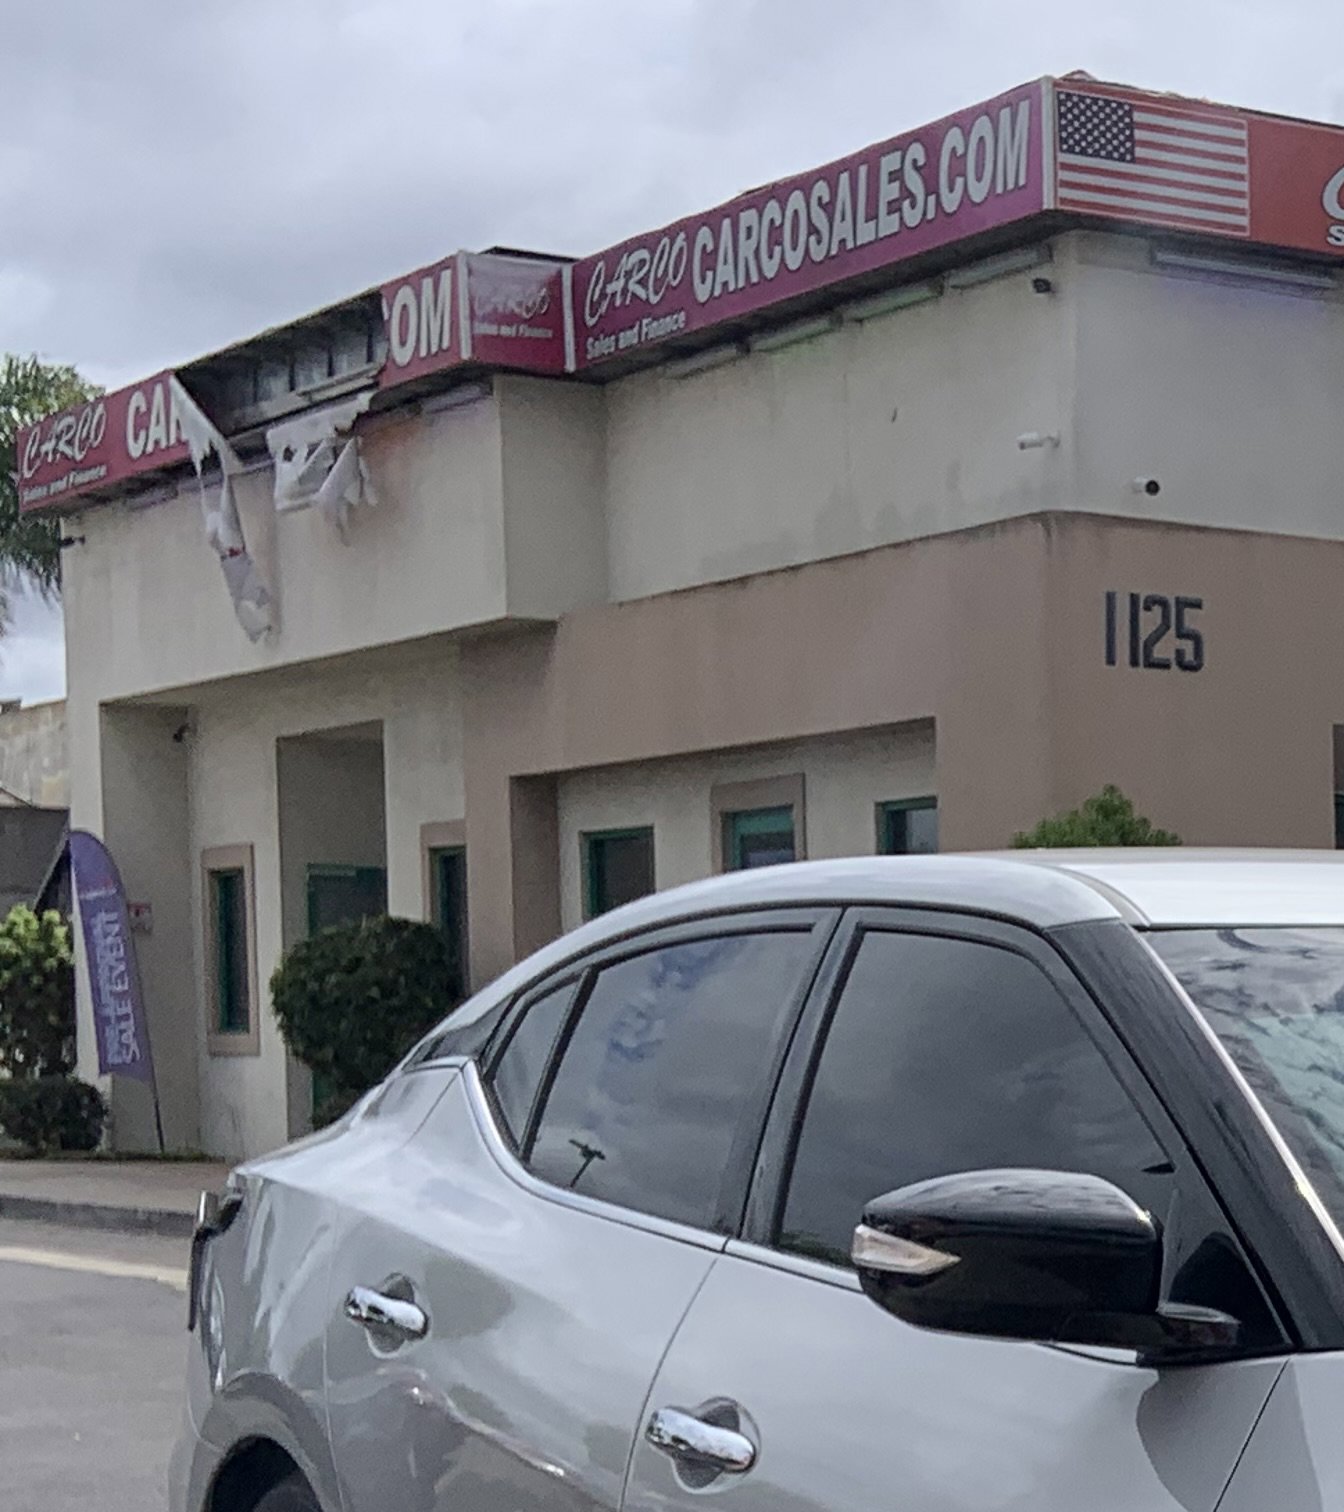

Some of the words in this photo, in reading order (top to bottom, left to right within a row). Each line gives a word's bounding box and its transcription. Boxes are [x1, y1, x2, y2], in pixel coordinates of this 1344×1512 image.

[584, 231, 688, 327] CARCO
[692, 101, 1032, 304] CARCOSALES.COM
[618, 320, 639, 349] and
[641, 311, 686, 341] Finance
[1105, 590, 1204, 672] 1125
[104, 910, 130, 992] EVENT
